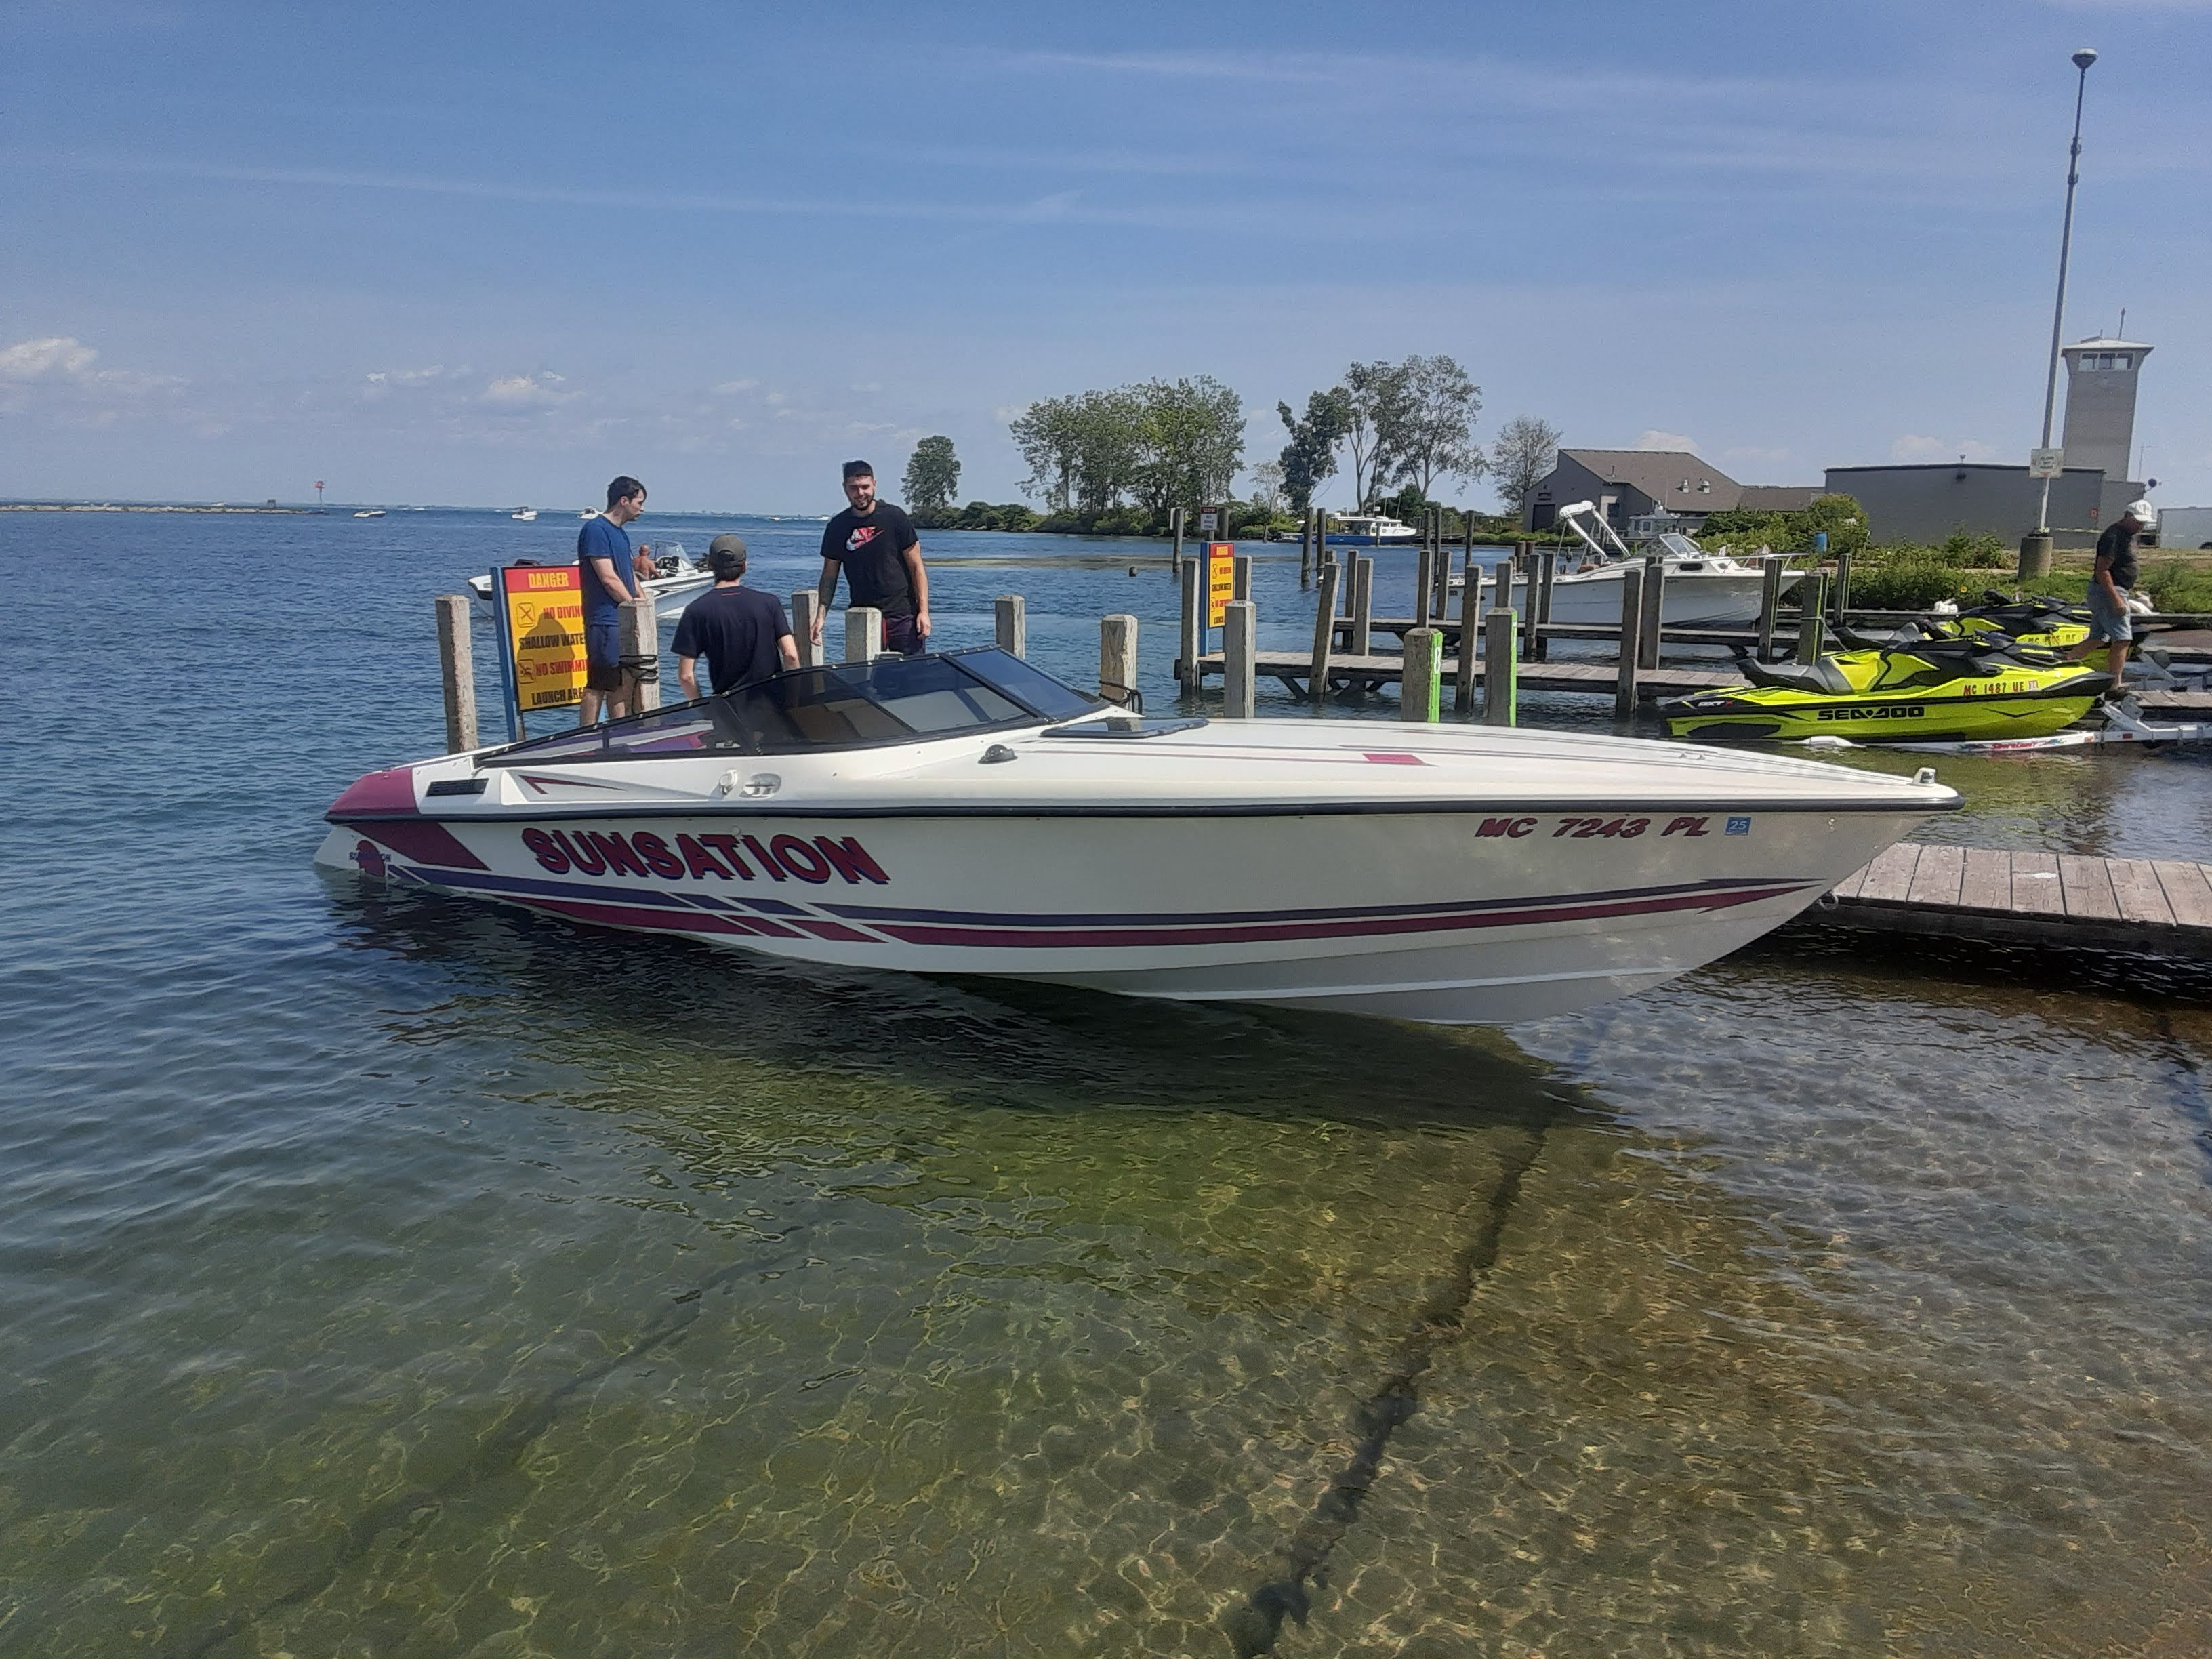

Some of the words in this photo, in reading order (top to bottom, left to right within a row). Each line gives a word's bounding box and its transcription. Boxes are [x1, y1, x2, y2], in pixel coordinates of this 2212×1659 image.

[527, 572, 569, 588] DANGER
[543, 607, 556, 619] NO
[556, 605, 582, 618] DIVIN
[519, 635, 560, 650] SHALLOW
[561, 633, 586, 647] WATE
[535, 663, 548, 676] NO
[550, 659, 588, 675] SWIMMI
[531, 689, 566, 705] LAUNCH
[567, 687, 585, 702] ARE
[1963, 684, 1977, 696] MC
[1474, 817, 1538, 838] MC
[1552, 817, 1651, 838] 7243
[1660, 817, 1710, 836] PL
[1729, 820, 1747, 831] 25
[521, 827, 893, 885] SUNSATION
